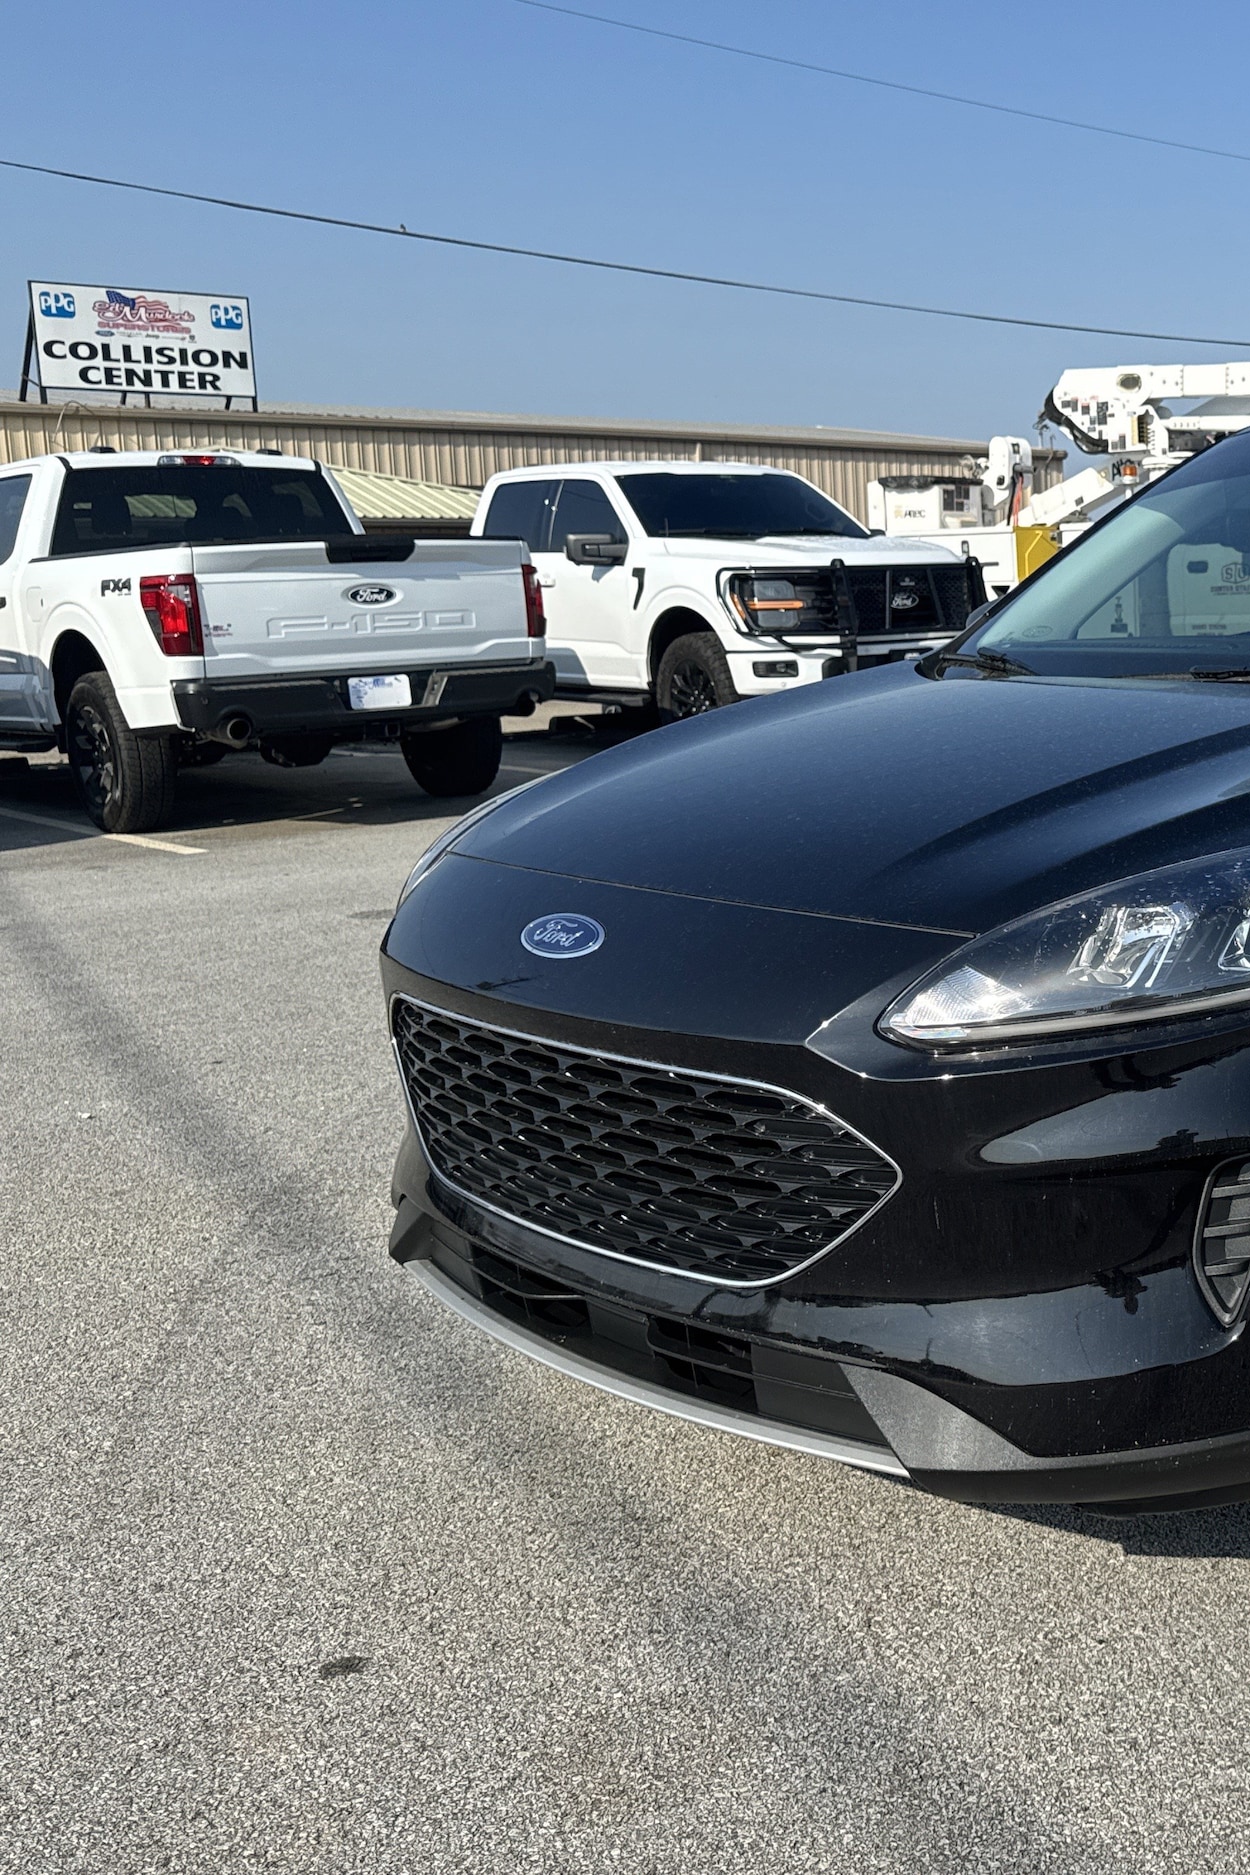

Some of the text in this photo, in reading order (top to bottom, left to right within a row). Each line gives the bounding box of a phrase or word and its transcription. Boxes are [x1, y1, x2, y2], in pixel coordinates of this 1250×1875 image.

[40, 292, 75, 314] PPG
[211, 304, 243, 327] PPG
[43, 340, 248, 370] COLLISION
[79, 366, 222, 391] CENTER
[101, 578, 131, 597] FX4
[357, 589, 387, 602] Ford
[267, 609, 476, 639] F-150
[534, 919, 584, 947] Ford
